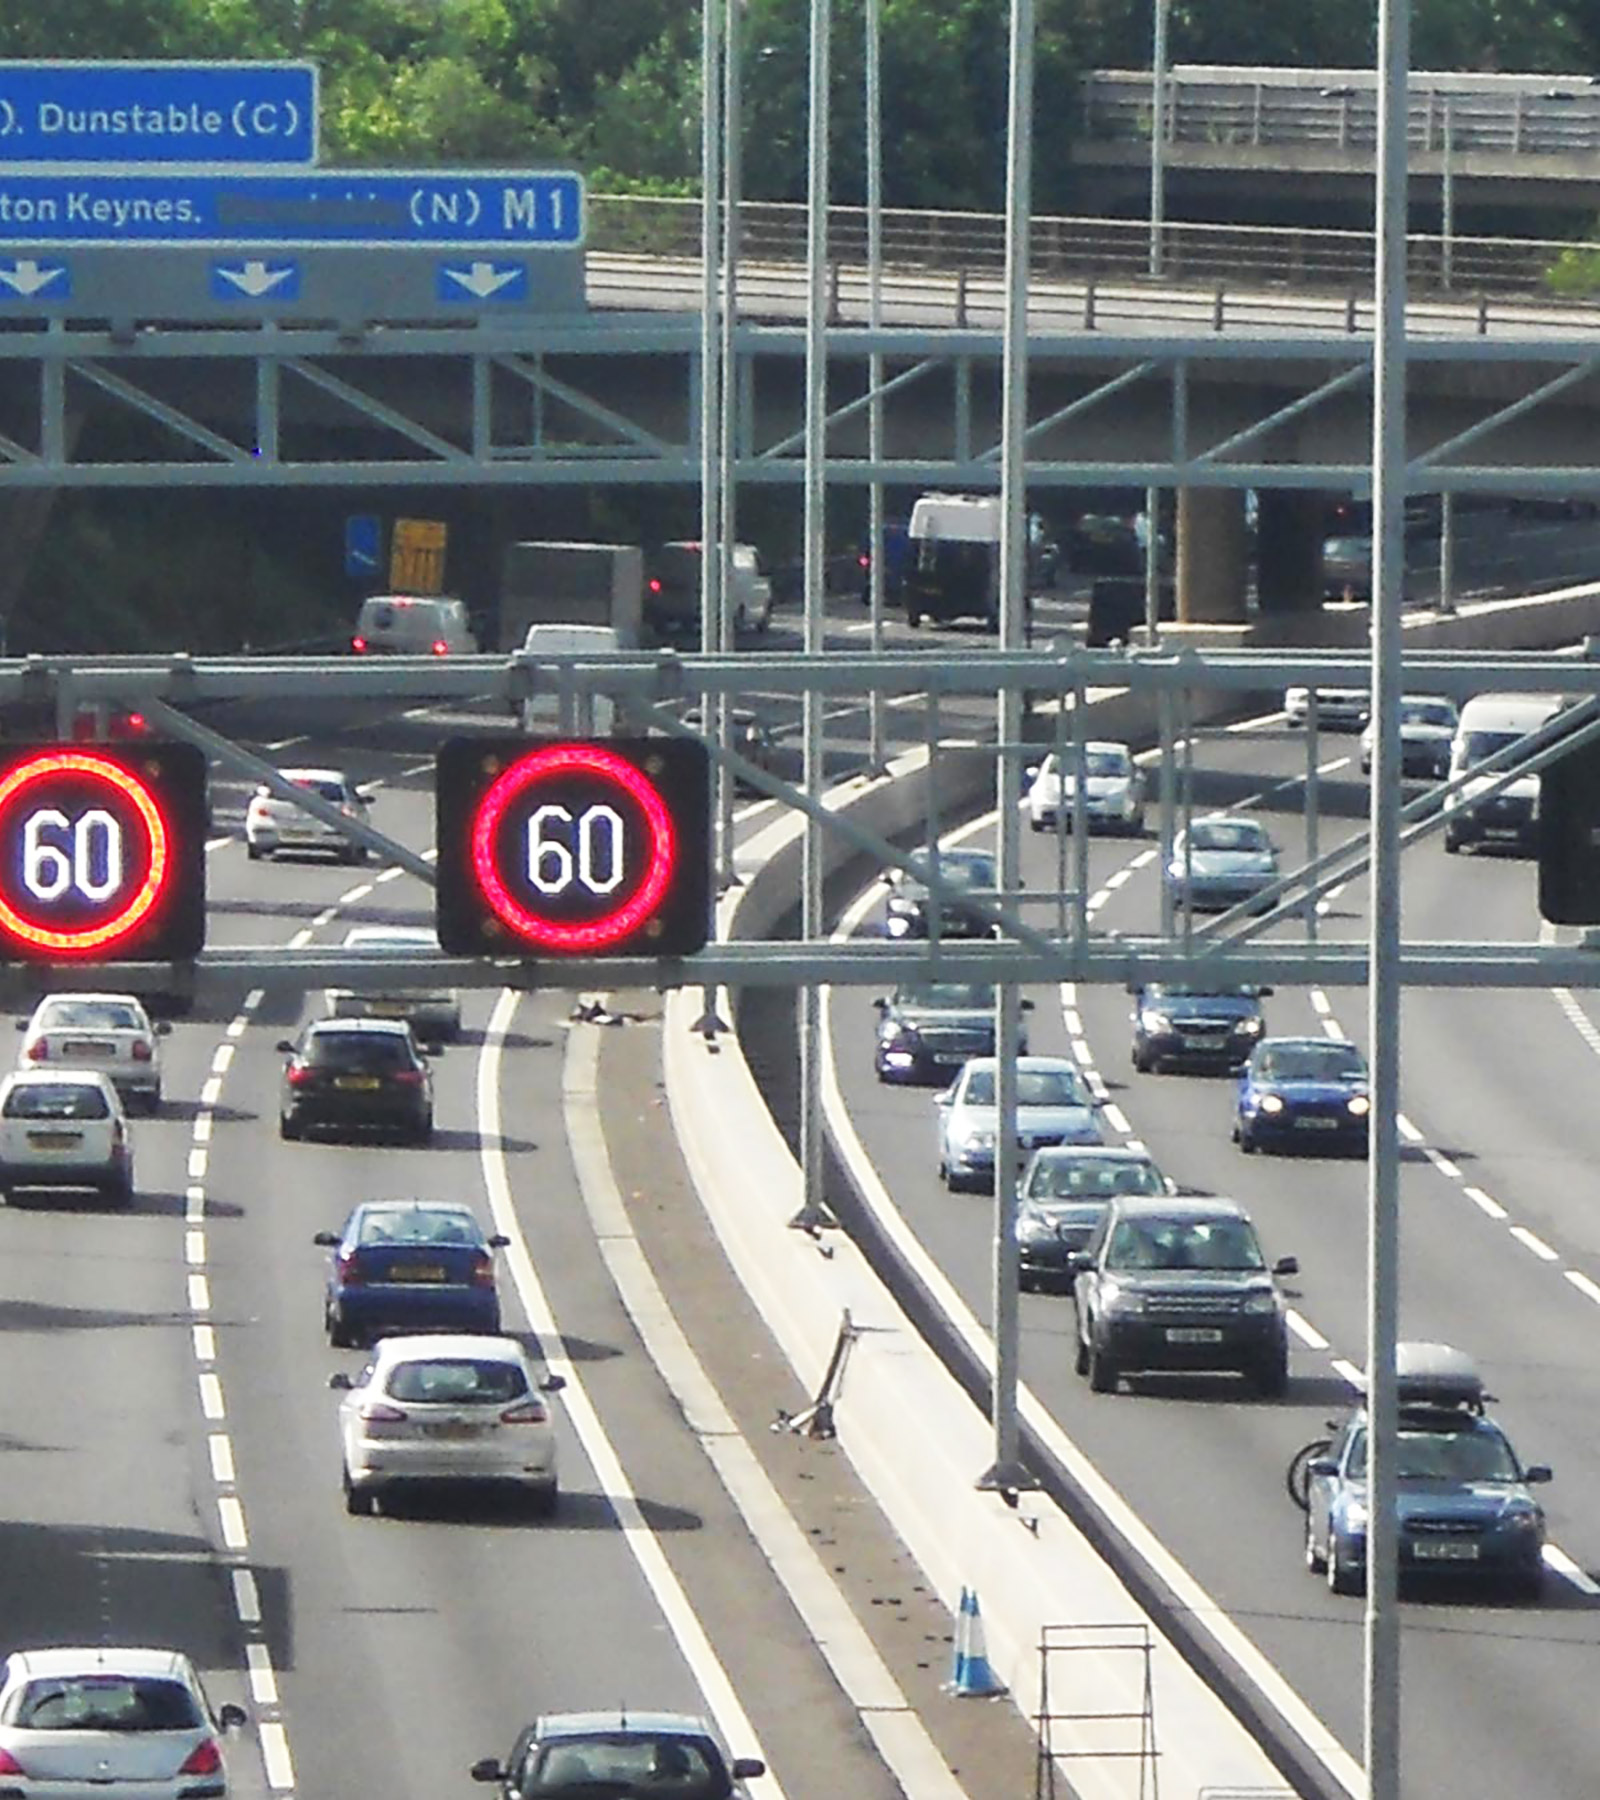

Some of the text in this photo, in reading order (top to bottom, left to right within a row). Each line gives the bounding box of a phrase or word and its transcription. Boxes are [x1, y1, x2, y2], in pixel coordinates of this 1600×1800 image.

[39, 102, 223, 134] Dunstable
[231, 99, 300, 138] (C)
[409, 188, 482, 227] (N)
[22, 807, 122, 902] 60
[526, 803, 626, 896] 60
